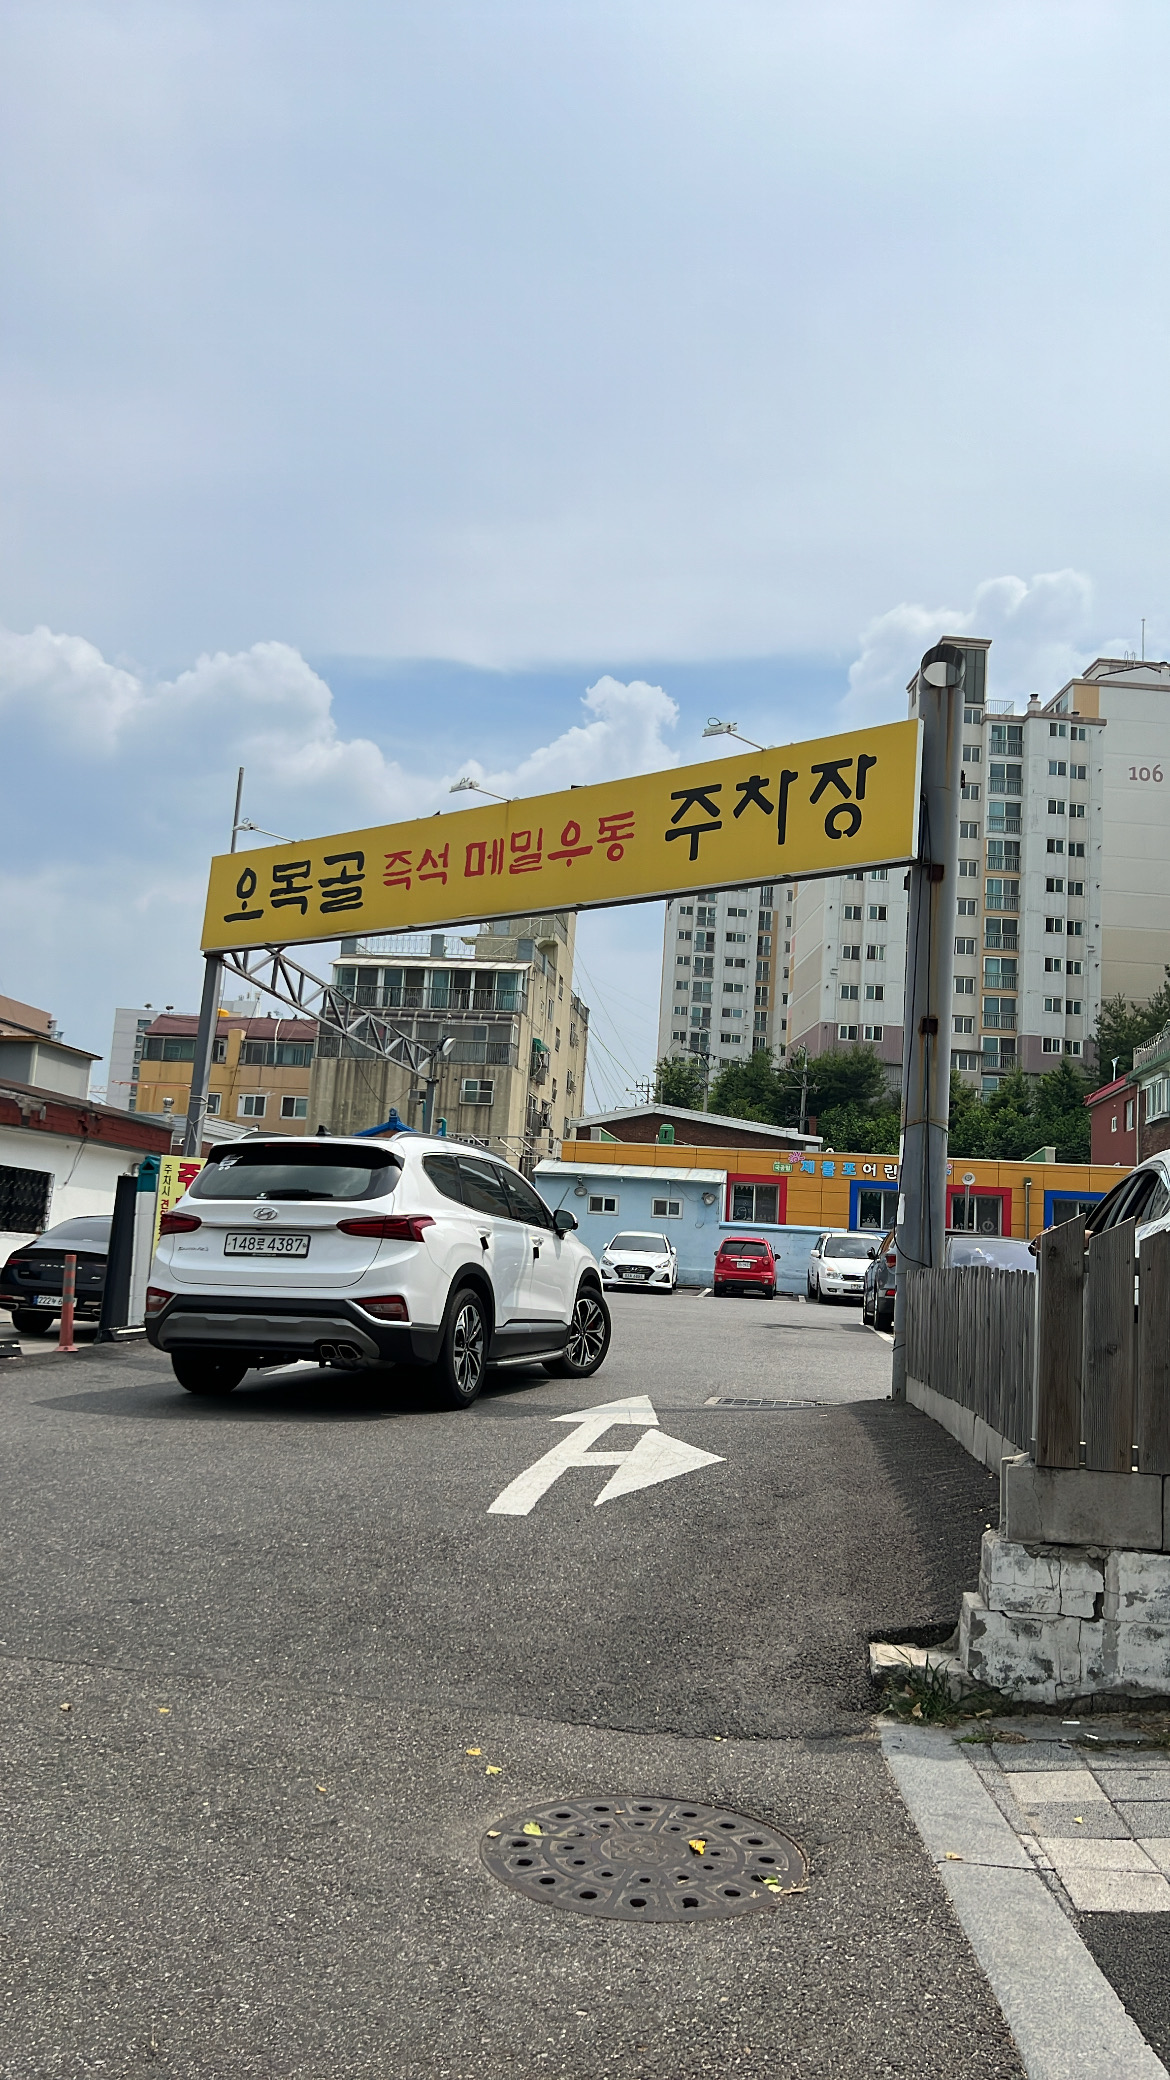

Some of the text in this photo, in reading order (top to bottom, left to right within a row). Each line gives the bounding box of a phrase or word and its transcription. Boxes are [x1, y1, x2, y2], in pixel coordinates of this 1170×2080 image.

[1128, 764, 1164, 783] 106
[223, 753, 877, 923] 오목골 즉석 메밀우동 주차장
[231, 1236, 304, 1252] 148로 4387
